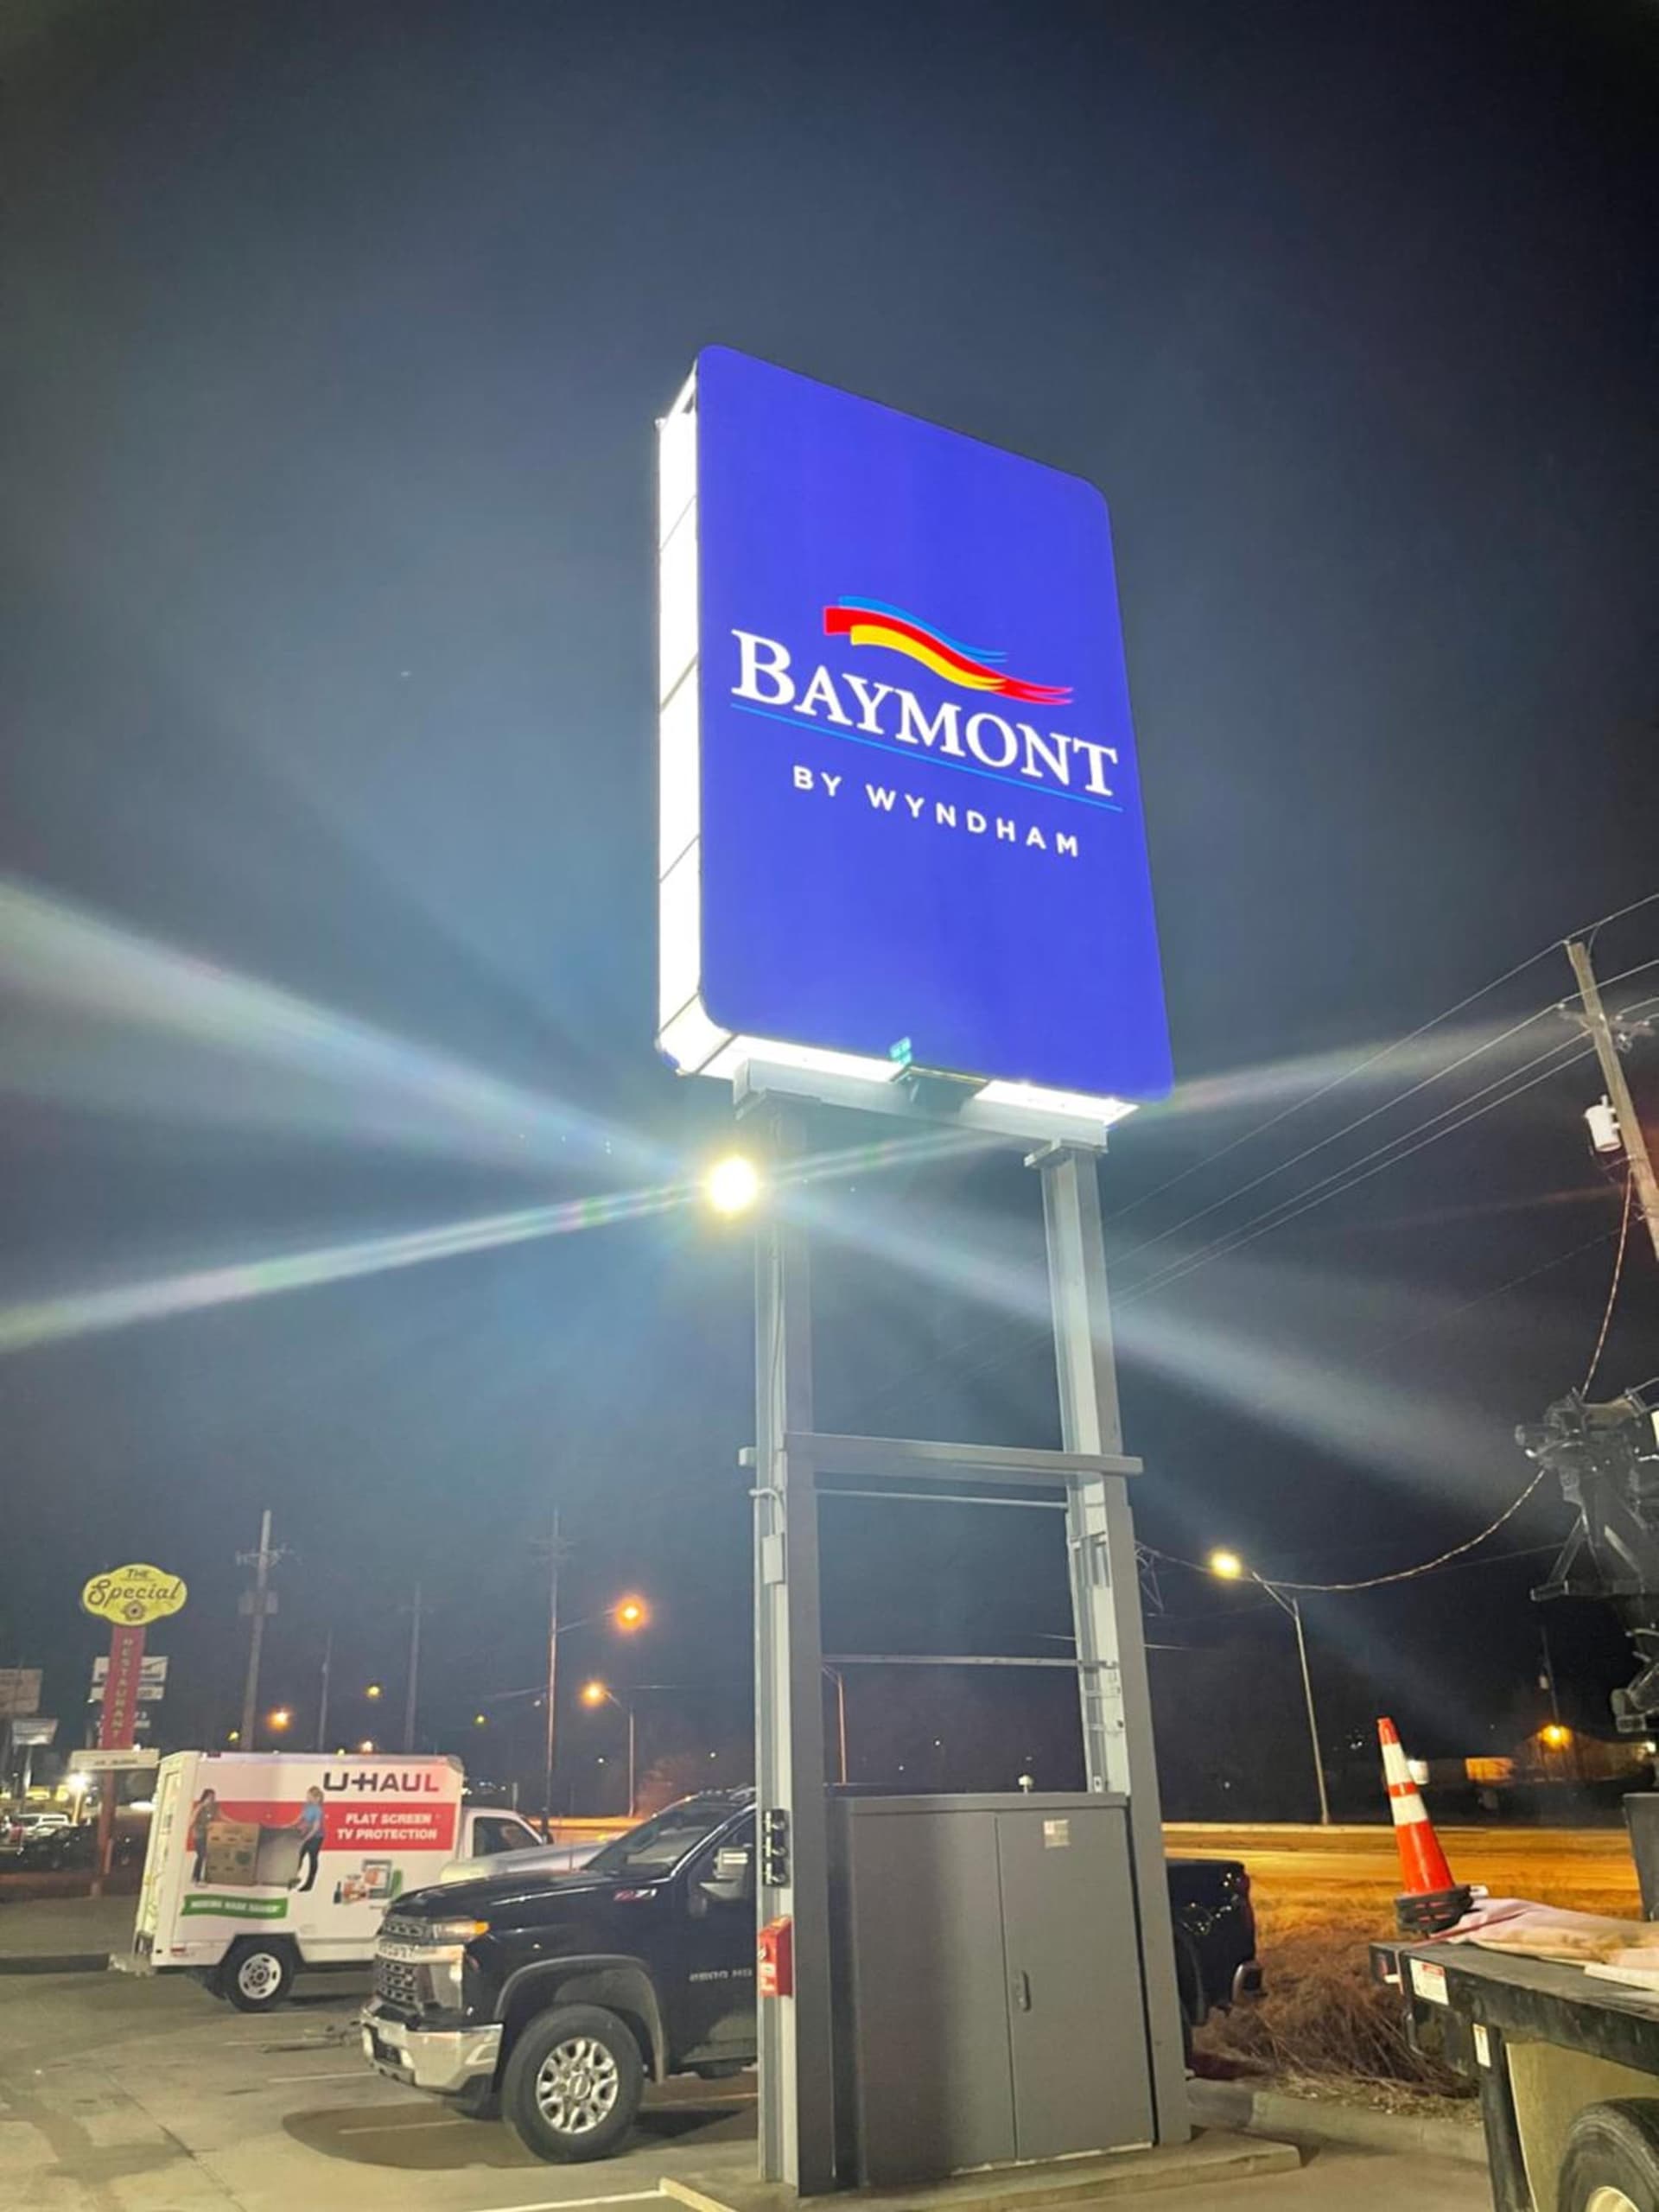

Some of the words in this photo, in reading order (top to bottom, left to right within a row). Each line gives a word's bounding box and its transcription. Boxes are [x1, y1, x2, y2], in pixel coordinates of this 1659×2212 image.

[731, 628, 1118, 797] BAYMONT
[792, 765, 842, 798] BY
[866, 785, 1078, 857] WYNDHAM
[88, 1579, 181, 1608] Special
[323, 1772, 440, 1792] U-HAUL
[346, 1813, 379, 1824] FLAT
[381, 1813, 432, 1825] SCREEN
[337, 1828, 353, 1840] TV
[355, 1827, 438, 1840] PROTECTION
